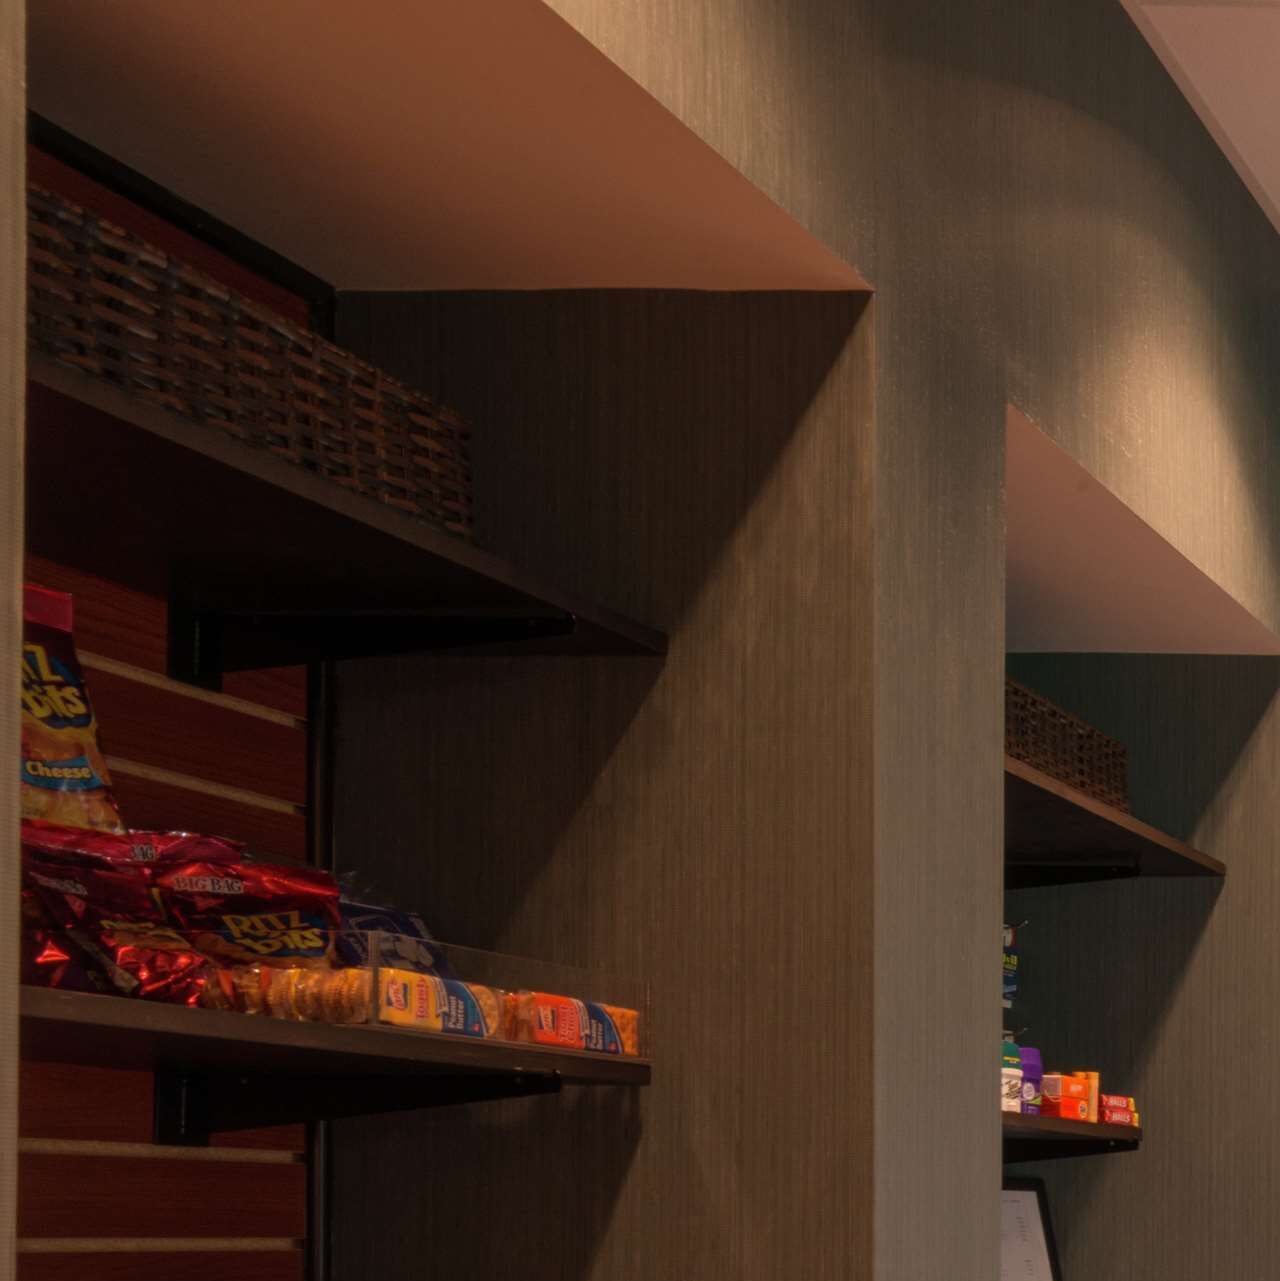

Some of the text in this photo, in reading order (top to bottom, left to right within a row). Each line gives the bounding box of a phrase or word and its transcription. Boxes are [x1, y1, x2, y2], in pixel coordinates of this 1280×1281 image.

[25, 760, 93, 779] Cheese
[209, 878, 243, 894] BAG
[223, 911, 308, 938] RITZ
[248, 929, 324, 954] bits
